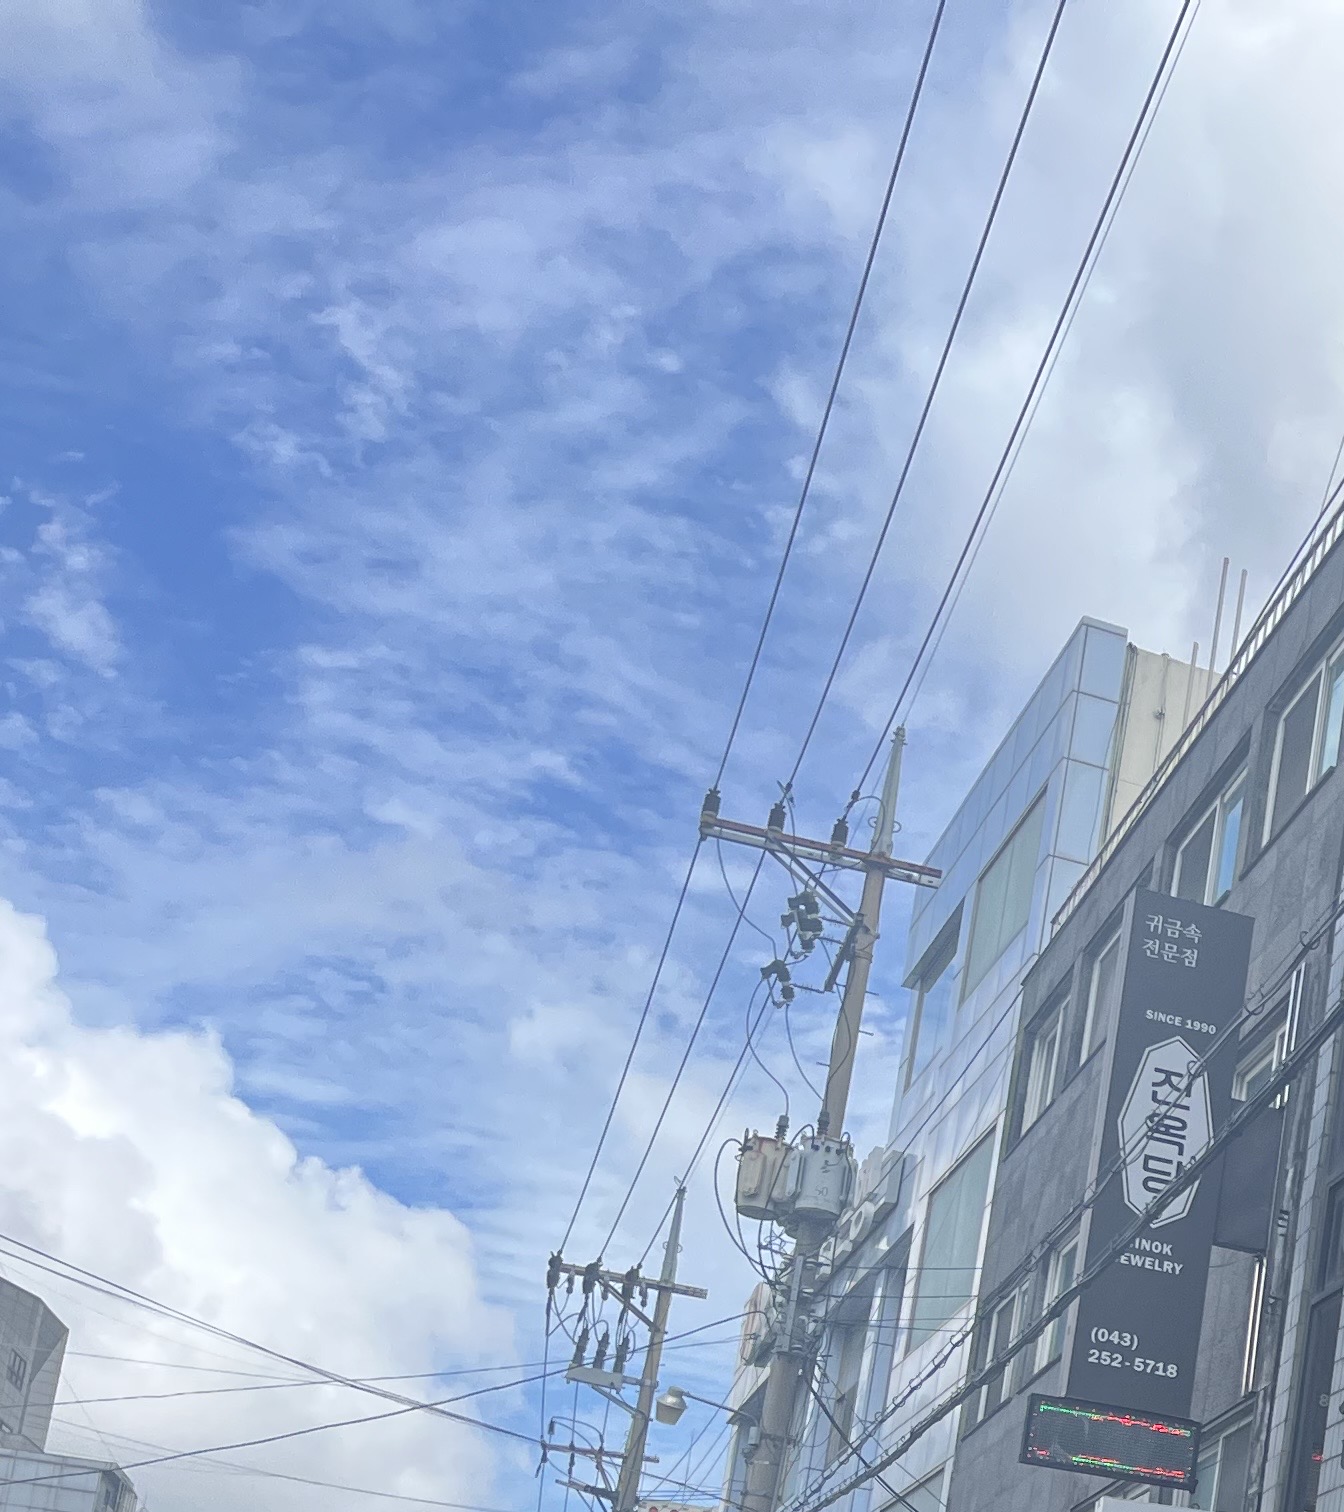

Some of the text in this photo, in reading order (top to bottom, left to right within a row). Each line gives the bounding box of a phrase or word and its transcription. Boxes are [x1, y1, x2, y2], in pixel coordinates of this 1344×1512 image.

[1145, 914, 1202, 944] 귀금속
[1142, 938, 1198, 968] 전문점
[1145, 1009, 1217, 1035] SINCE 1990
[1130, 1237, 1173, 1256] INOK
[1116, 1252, 1184, 1276] EWELRY
[1090, 1326, 1139, 1351] (043)
[1087, 1349, 1179, 1379] 252-5718
